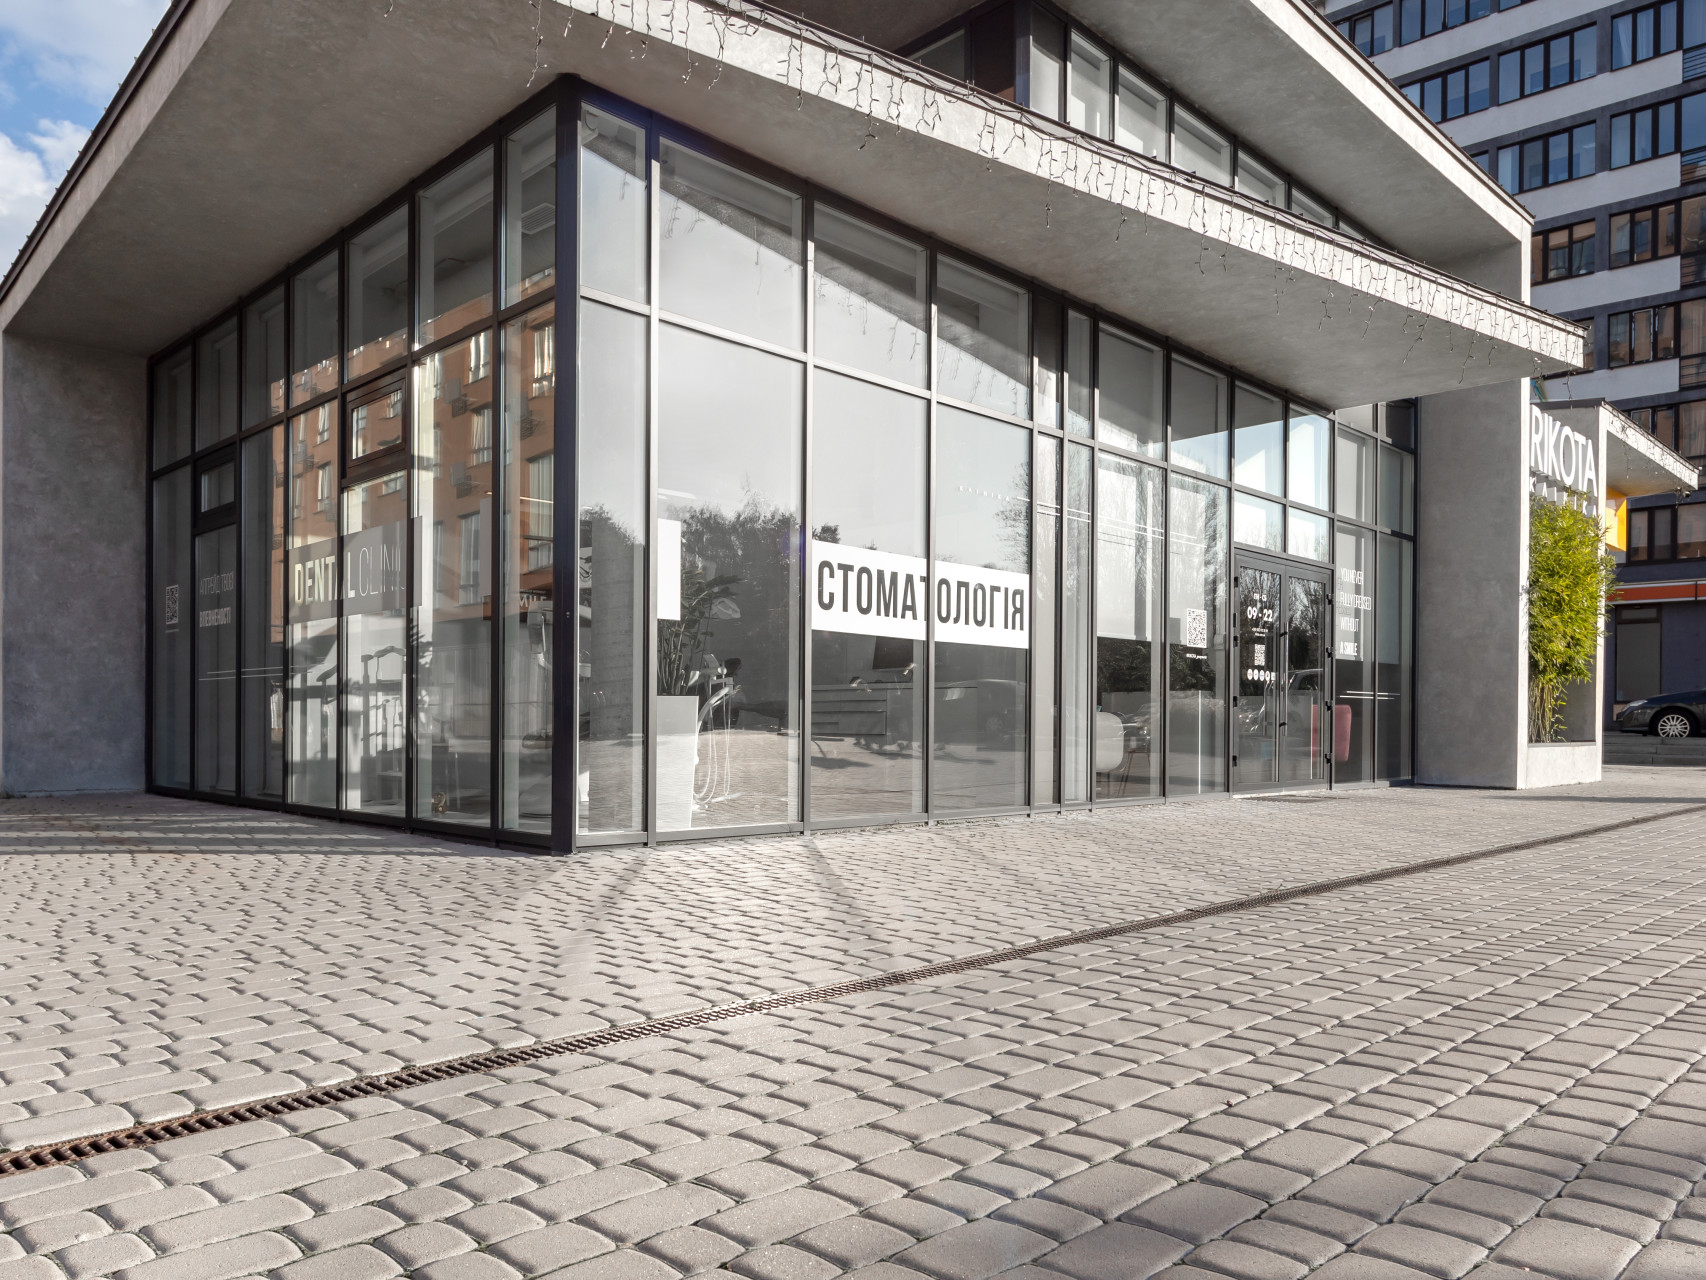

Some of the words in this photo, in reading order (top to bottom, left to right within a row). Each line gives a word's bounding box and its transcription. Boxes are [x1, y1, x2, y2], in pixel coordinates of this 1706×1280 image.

[1530, 404, 1598, 498] RIKOTA
[1247, 606, 1257, 620] 09
[1263, 609, 1273, 622] 22
[1339, 616, 1359, 632] WITHOUT
[1344, 642, 1358, 656] SMILE
